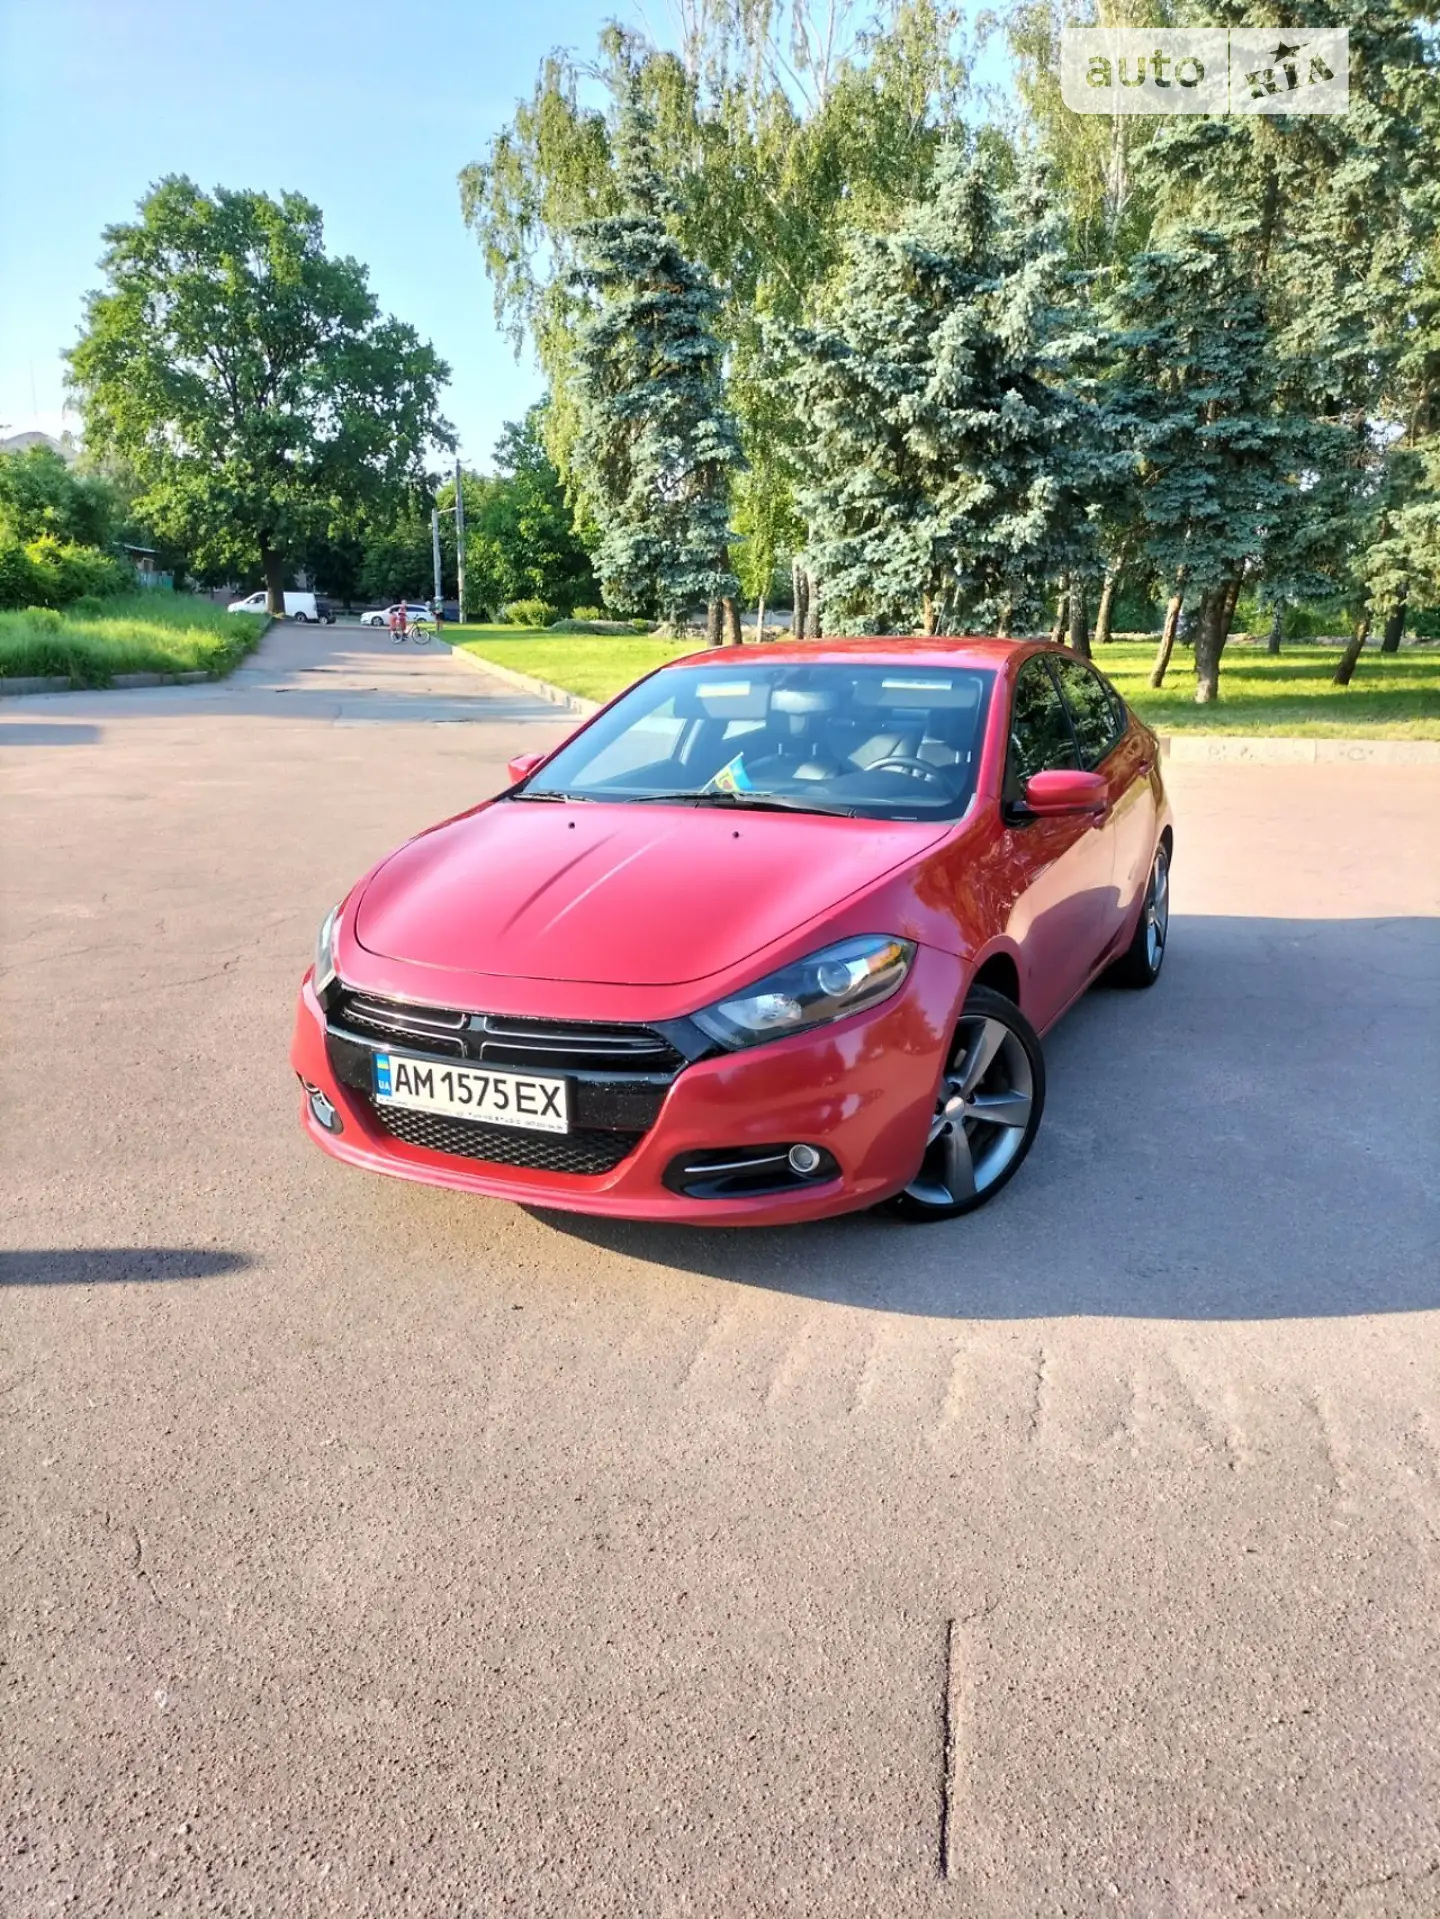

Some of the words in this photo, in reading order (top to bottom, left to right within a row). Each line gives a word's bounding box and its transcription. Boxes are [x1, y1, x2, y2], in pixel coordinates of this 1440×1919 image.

[378, 1079, 391, 1091] UA
[395, 1063, 435, 1099] AM
[440, 1071, 510, 1110] 1575
